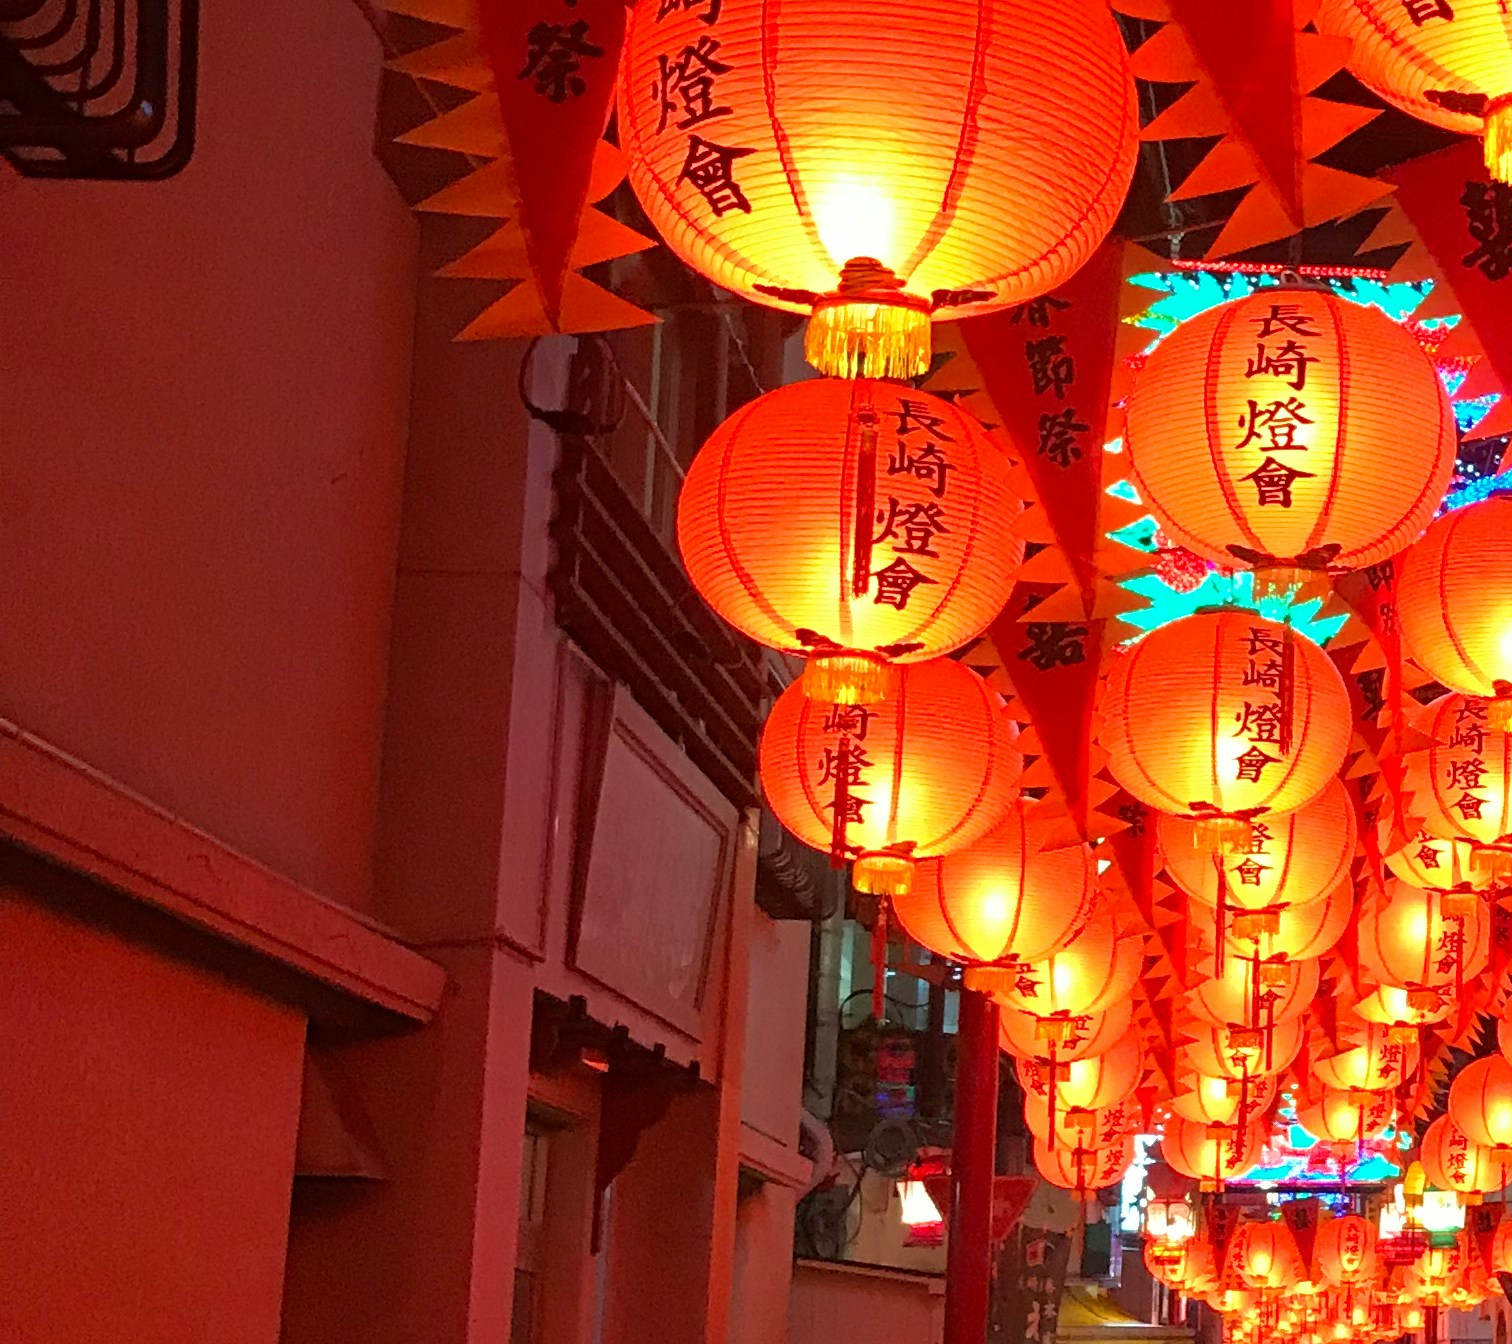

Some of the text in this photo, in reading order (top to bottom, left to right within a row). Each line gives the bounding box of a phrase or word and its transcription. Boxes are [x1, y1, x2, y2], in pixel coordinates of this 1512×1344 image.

[871, 396, 957, 611] 長崎燈會
[1235, 303, 1322, 509] 長崎燈會
